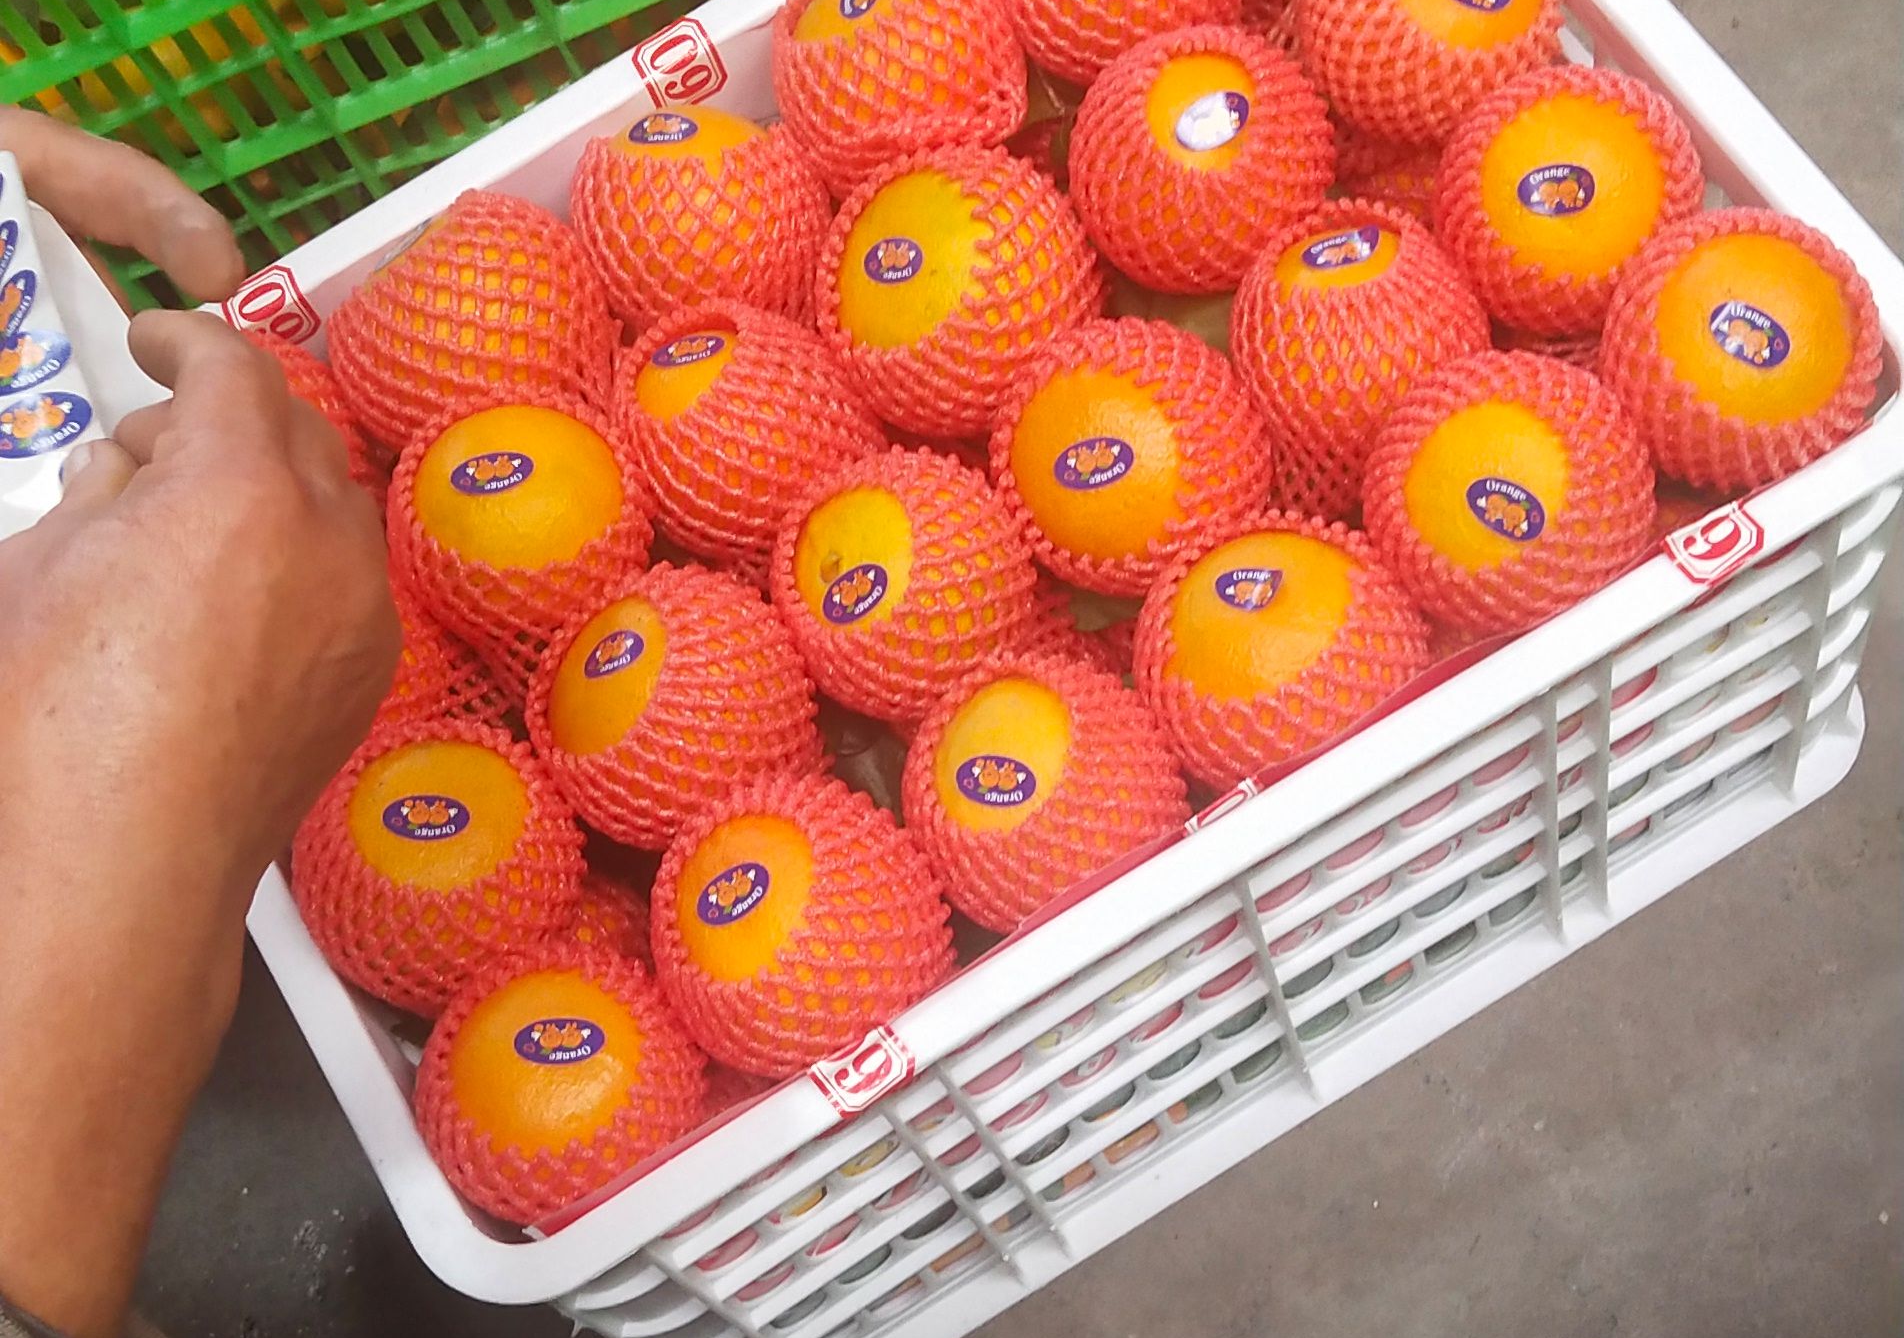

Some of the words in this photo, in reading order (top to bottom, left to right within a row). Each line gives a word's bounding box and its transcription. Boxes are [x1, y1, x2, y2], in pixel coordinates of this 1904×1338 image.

[1529, 168, 1570, 183] Orange
[882, 267, 912, 280] Orange
[1731, 302, 1771, 329] Orange
[484, 472, 523, 490] Orange
[1089, 461, 1126, 485] Orange
[1486, 479, 1527, 500] Orange
[854, 586, 883, 615] Orange
[984, 790, 1023, 803] Orange
[414, 824, 455, 836] Orange
[731, 885, 763, 916] Orange
[549, 1045, 591, 1061] Orange
